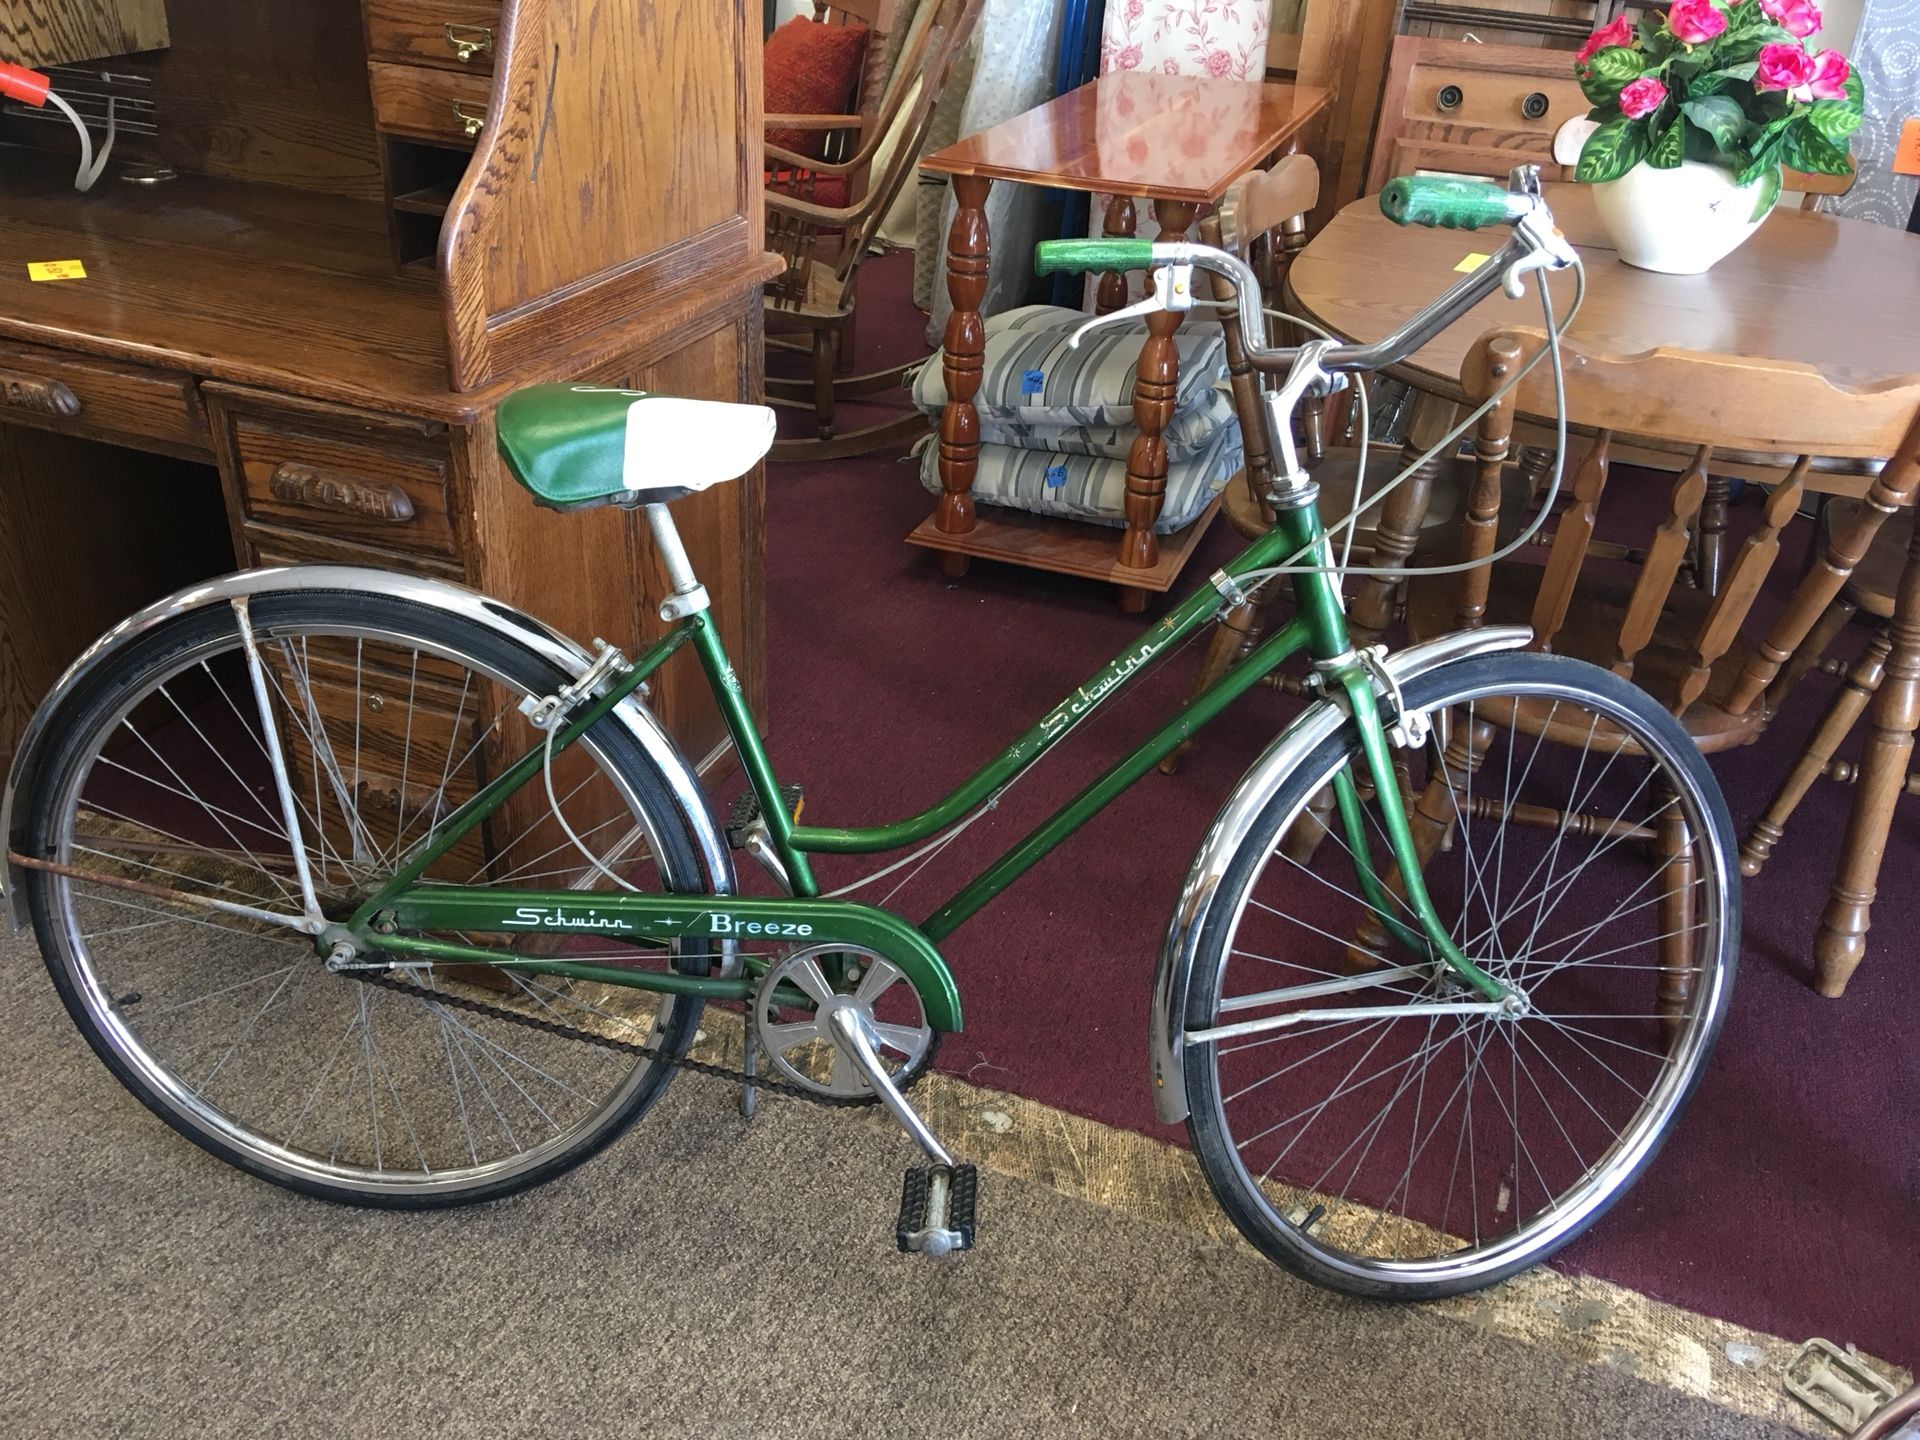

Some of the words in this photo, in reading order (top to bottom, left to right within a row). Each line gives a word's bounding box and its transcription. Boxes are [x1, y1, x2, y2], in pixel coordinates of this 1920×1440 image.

[1037, 642, 1162, 747] Schwinn
[501, 908, 632, 928] Schwinn
[709, 913, 813, 935] Breeze
